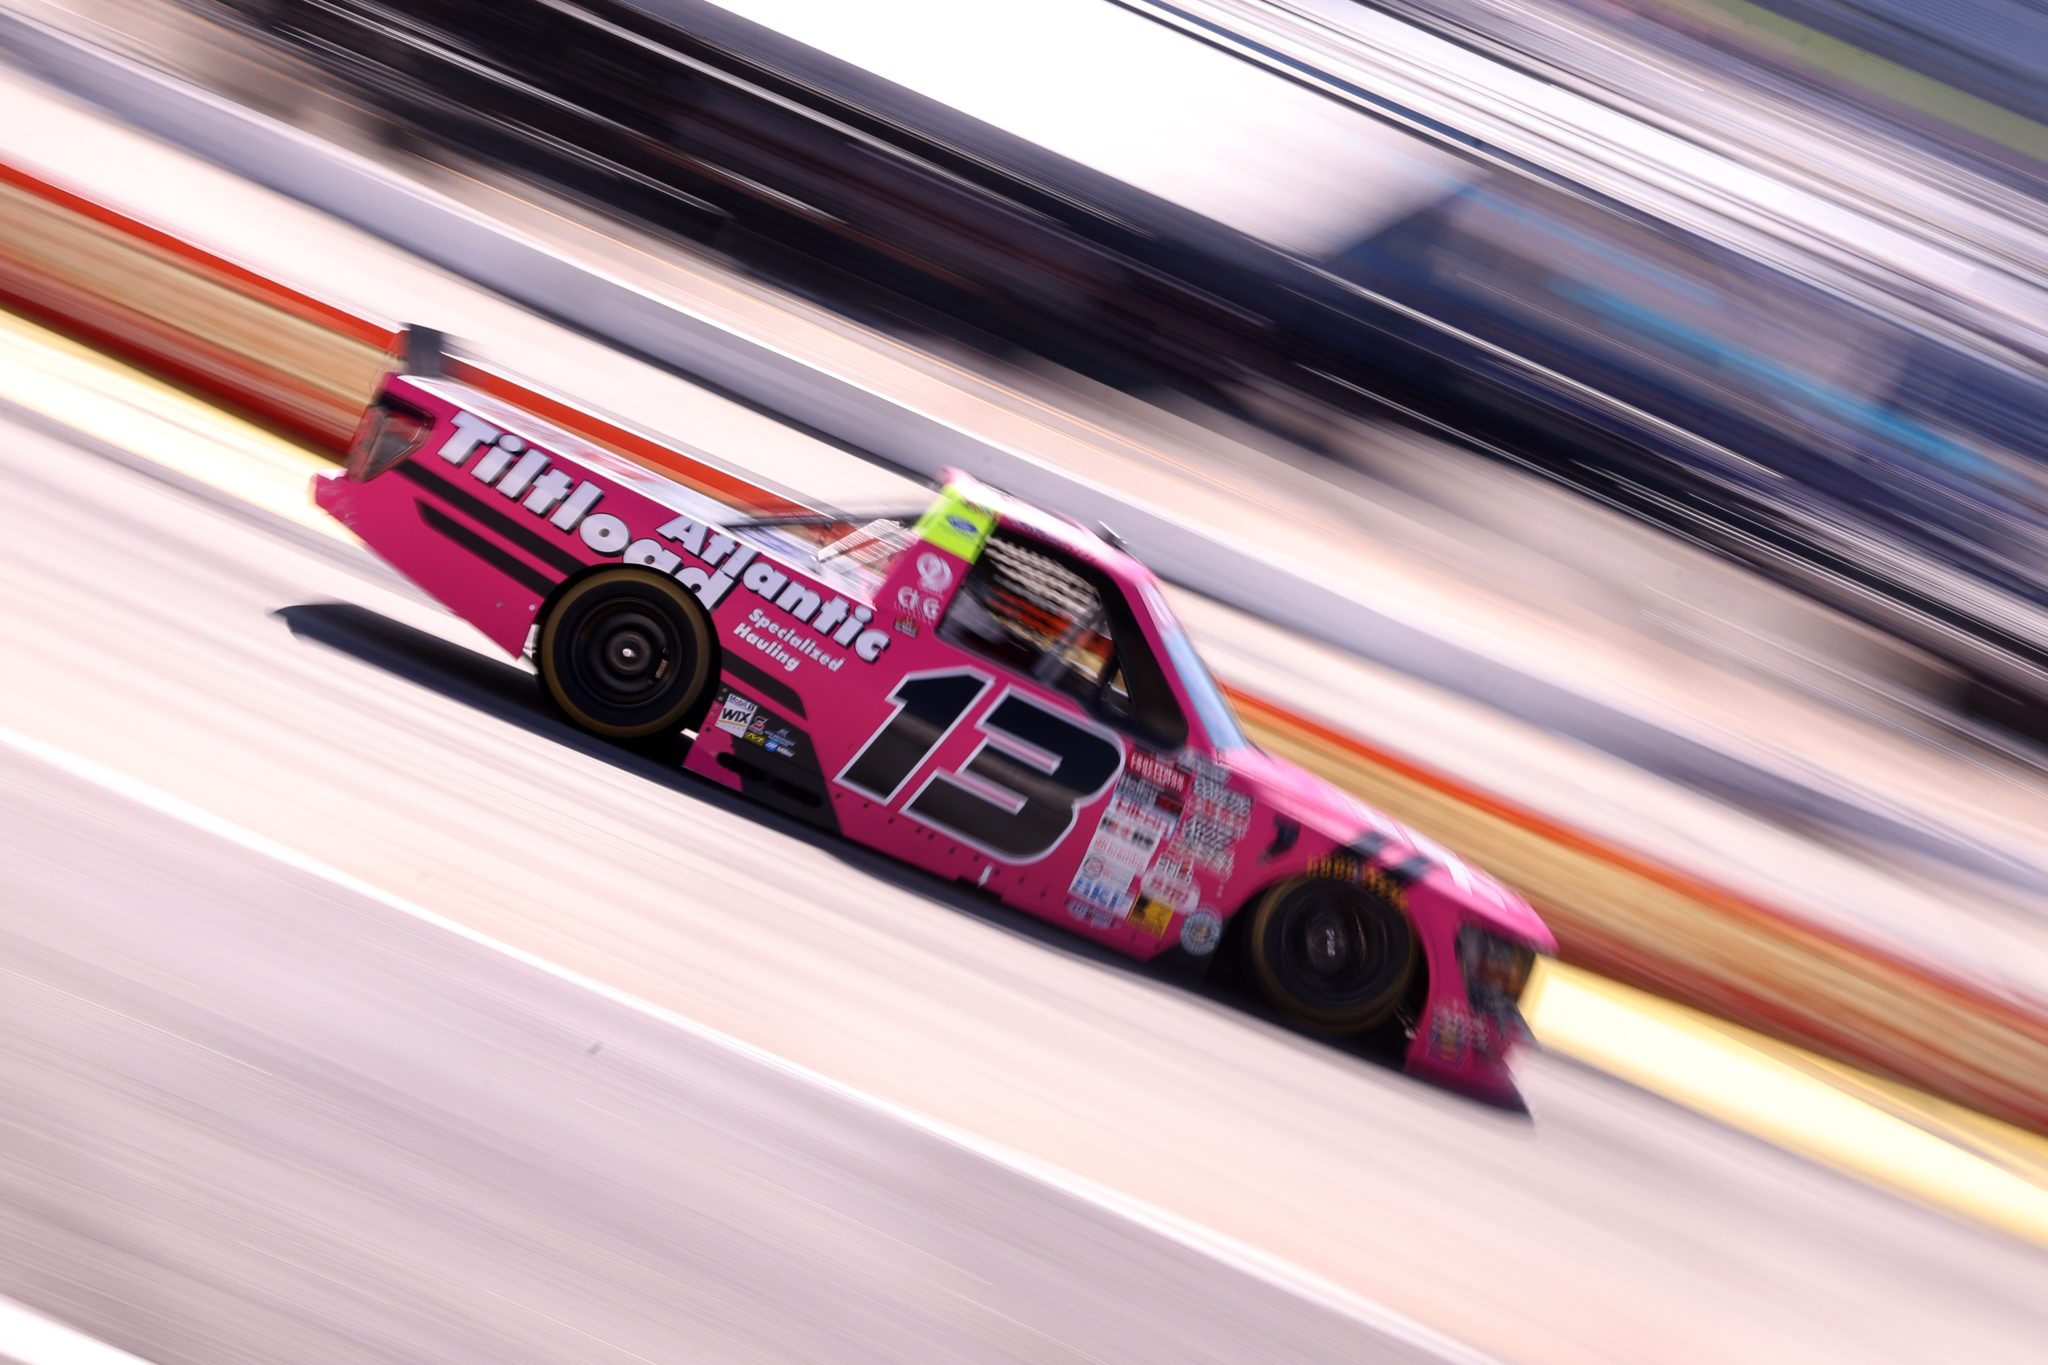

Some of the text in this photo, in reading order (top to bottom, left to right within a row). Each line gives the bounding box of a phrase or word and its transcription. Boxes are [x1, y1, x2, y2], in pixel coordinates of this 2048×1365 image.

[655, 514, 891, 663] Atlantic
[733, 622, 802, 672] Hauling
[748, 607, 846, 673] Specialized
[721, 708, 751, 724] WIX
[832, 665, 1127, 866] 13
